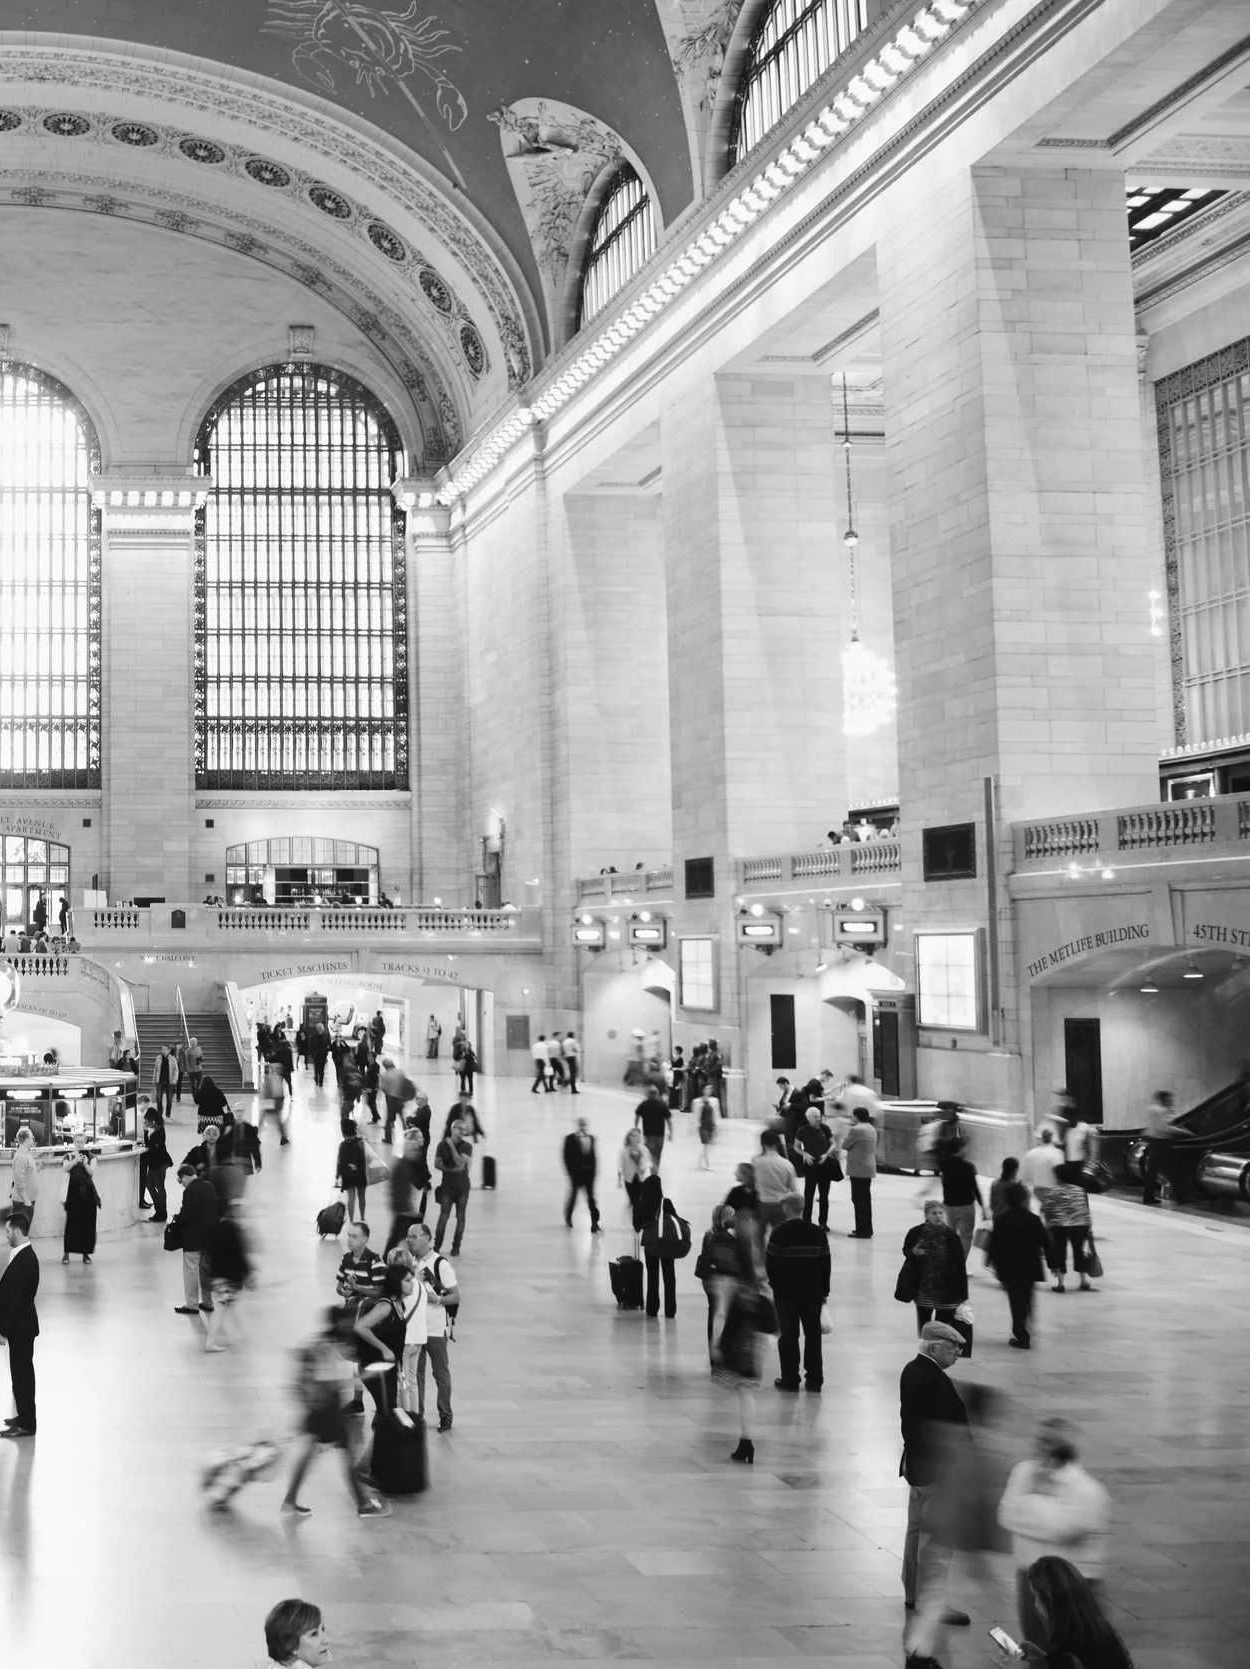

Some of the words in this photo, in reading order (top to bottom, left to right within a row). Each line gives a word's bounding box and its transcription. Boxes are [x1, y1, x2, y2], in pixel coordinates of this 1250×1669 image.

[5, 824, 62, 840] APARTMENT
[16, 817, 55, 830] AVENUE
[1193, 924, 1227, 942] 45TH
[1027, 956, 1050, 977] THE
[1049, 936, 1093, 966] METLIFE
[1095, 924, 1150, 948] BUILDING
[260, 967, 294, 980] TICKET
[297, 961, 348, 974] MACHINES
[382, 962, 420, 973] TRACKS
[433, 968, 447, 977] TO
[448, 971, 458, 980] 42
